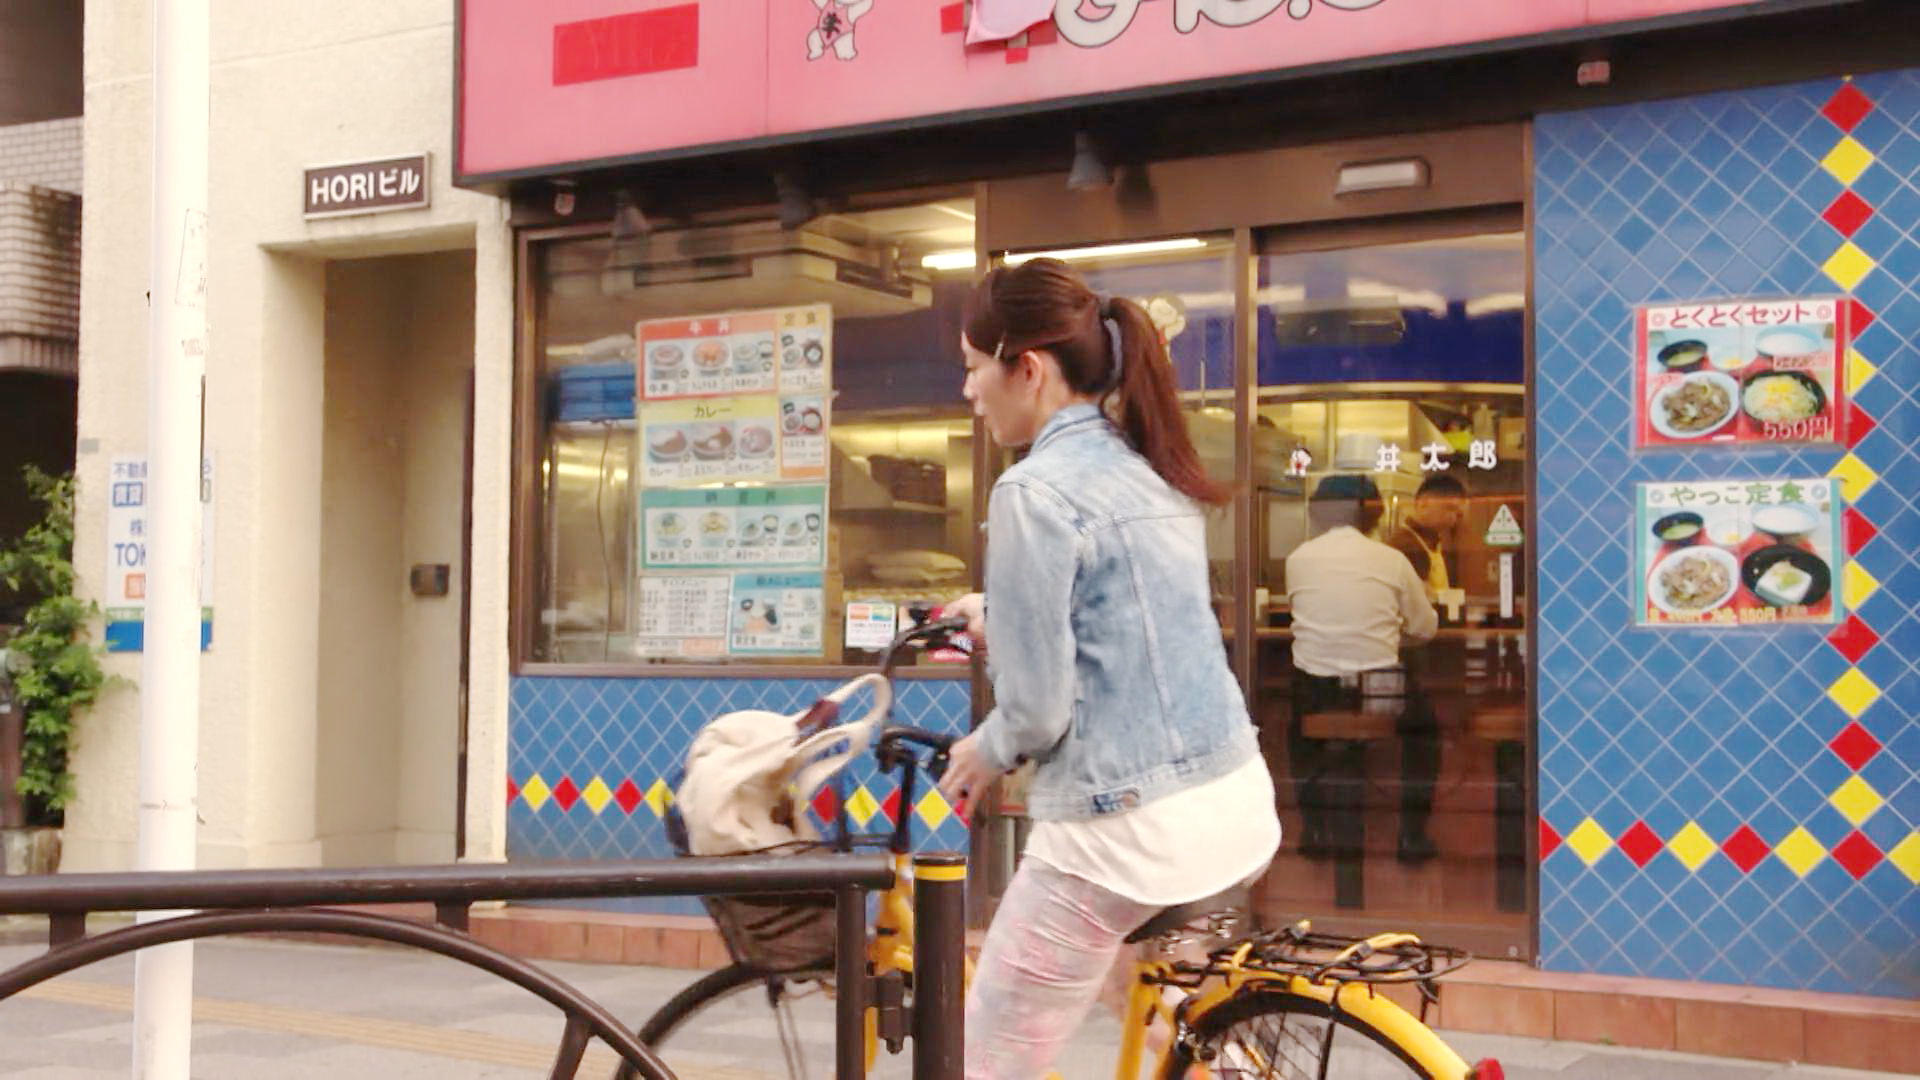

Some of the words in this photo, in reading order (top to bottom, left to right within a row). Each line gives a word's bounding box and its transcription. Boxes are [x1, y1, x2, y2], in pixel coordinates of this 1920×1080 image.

[1669, 303, 1810, 328] とくとくセット
[694, 403, 731, 418] カレー
[1763, 416, 1829, 440] 550円
[1669, 481, 1806, 505] やっこ定食
